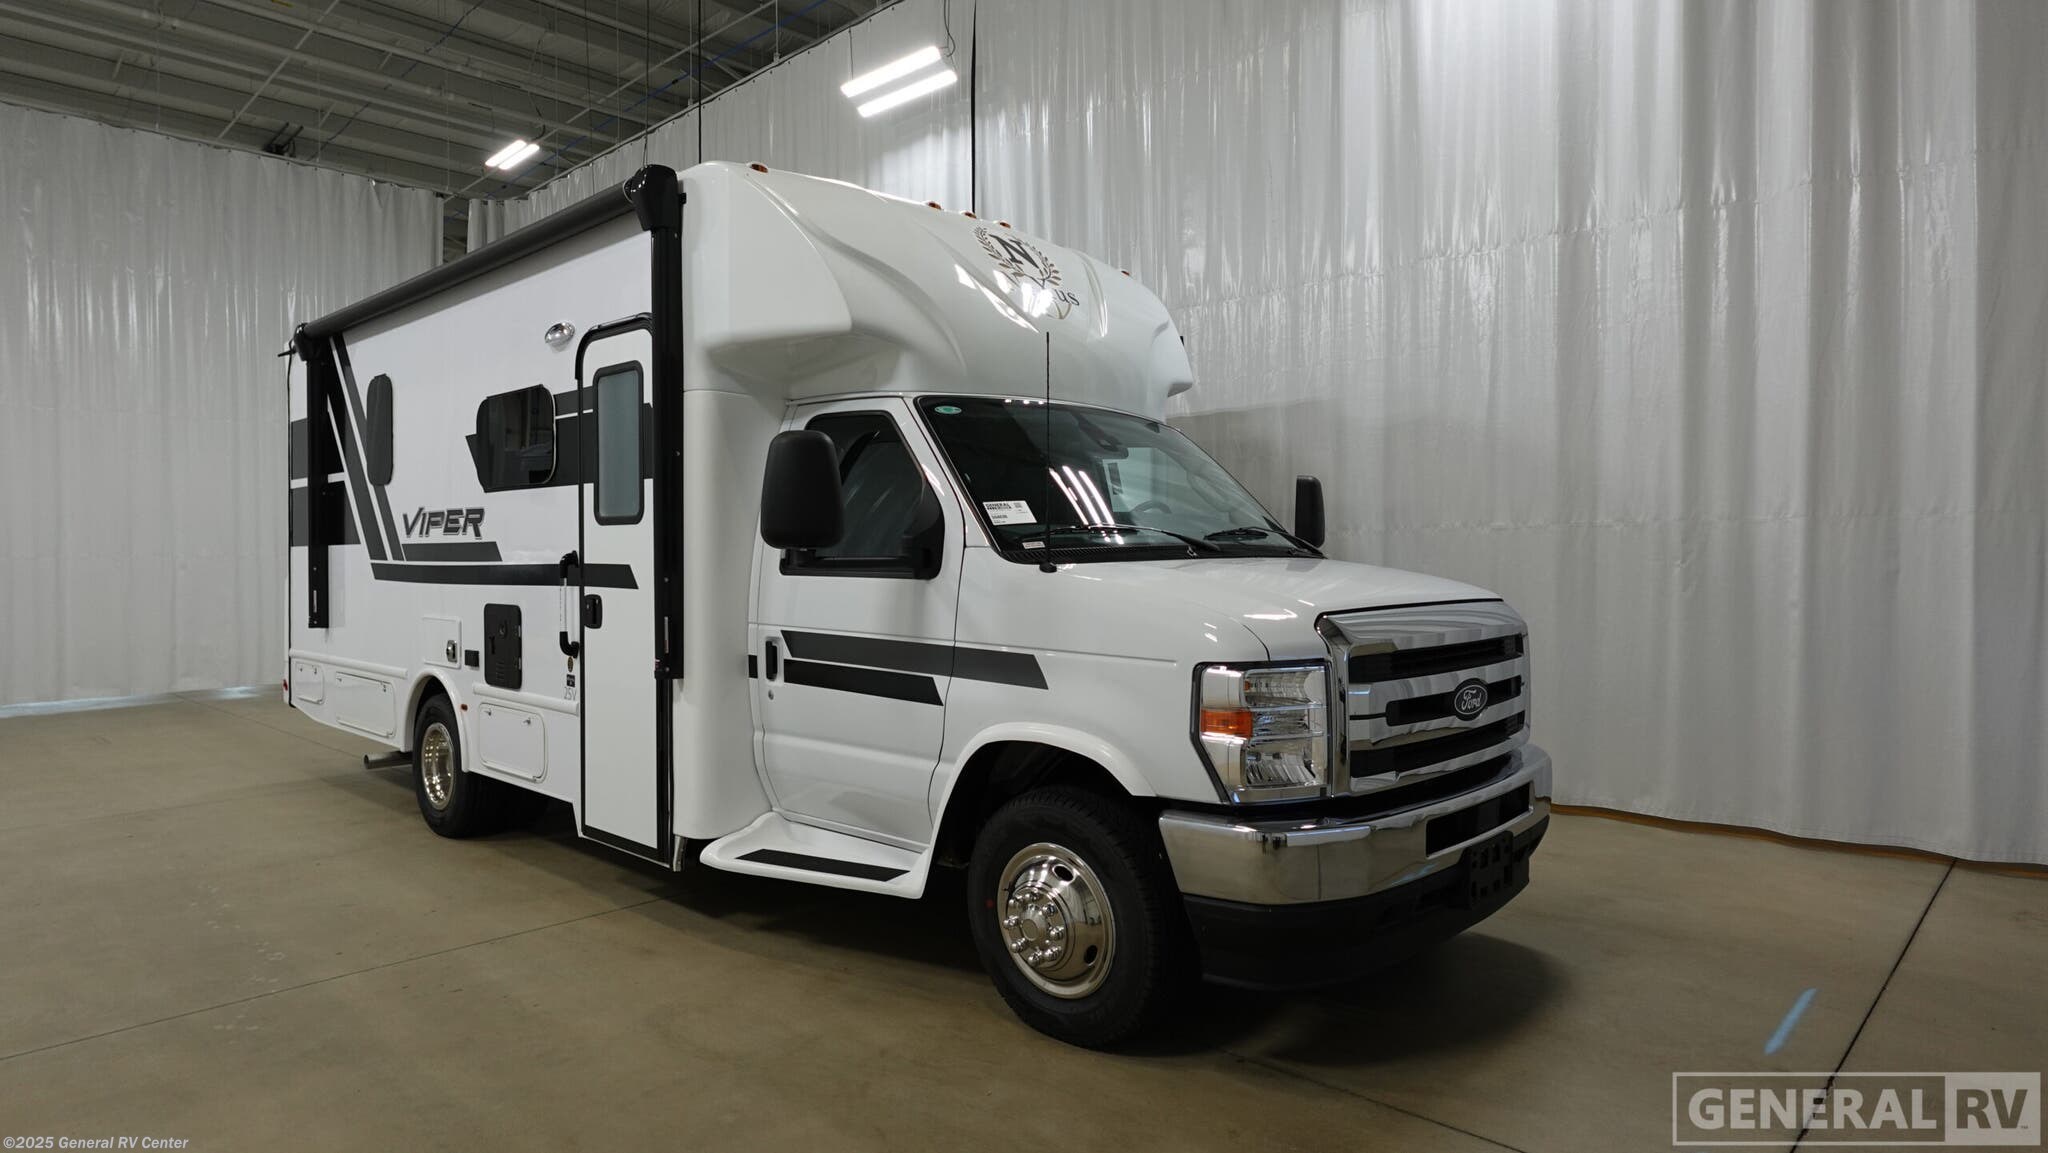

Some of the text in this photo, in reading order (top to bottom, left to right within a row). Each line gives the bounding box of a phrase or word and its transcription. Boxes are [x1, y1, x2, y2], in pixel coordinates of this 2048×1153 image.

[989, 233, 1041, 269] N
[402, 506, 485, 540] VIPER
[1461, 688, 1482, 711] Ford
